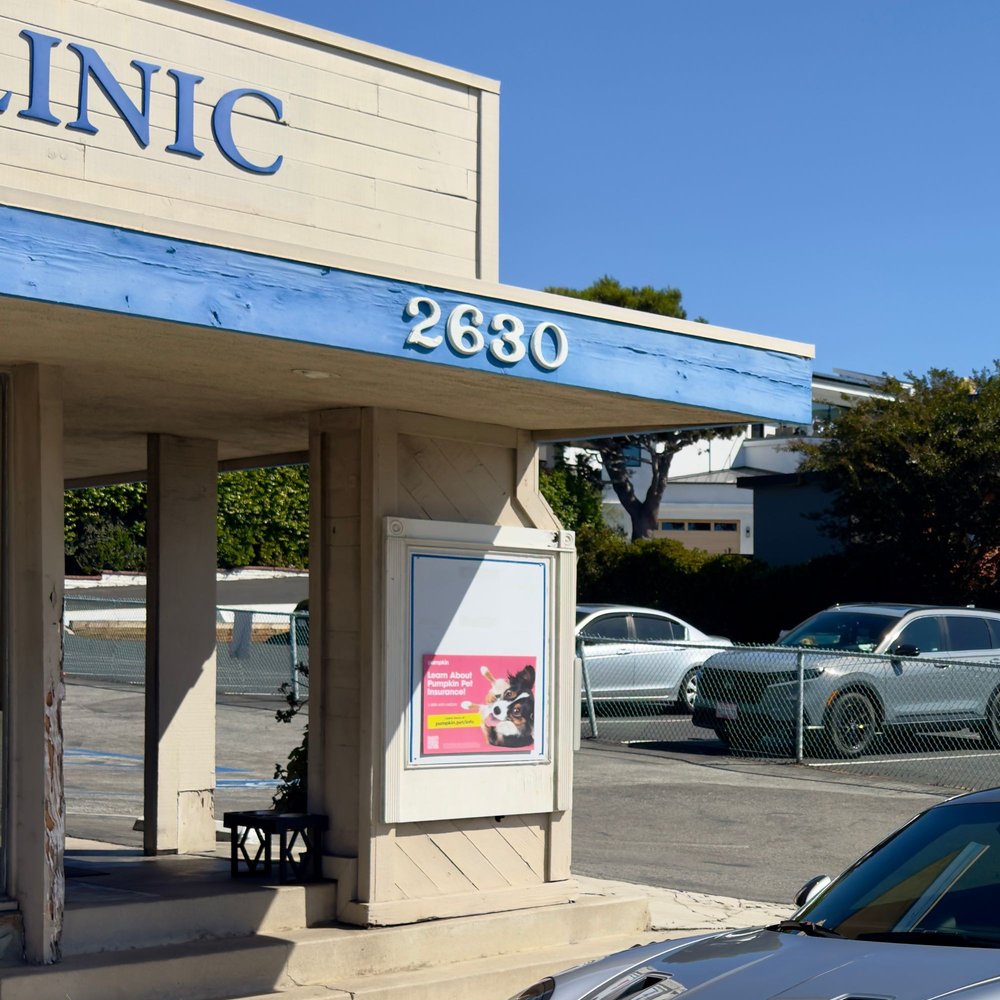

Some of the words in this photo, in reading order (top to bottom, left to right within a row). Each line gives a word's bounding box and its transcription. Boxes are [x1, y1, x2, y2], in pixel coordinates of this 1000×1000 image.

[0, 29, 283, 176] INIC
[406, 296, 569, 370] 2630
[427, 680, 459, 688] Pumpkin
